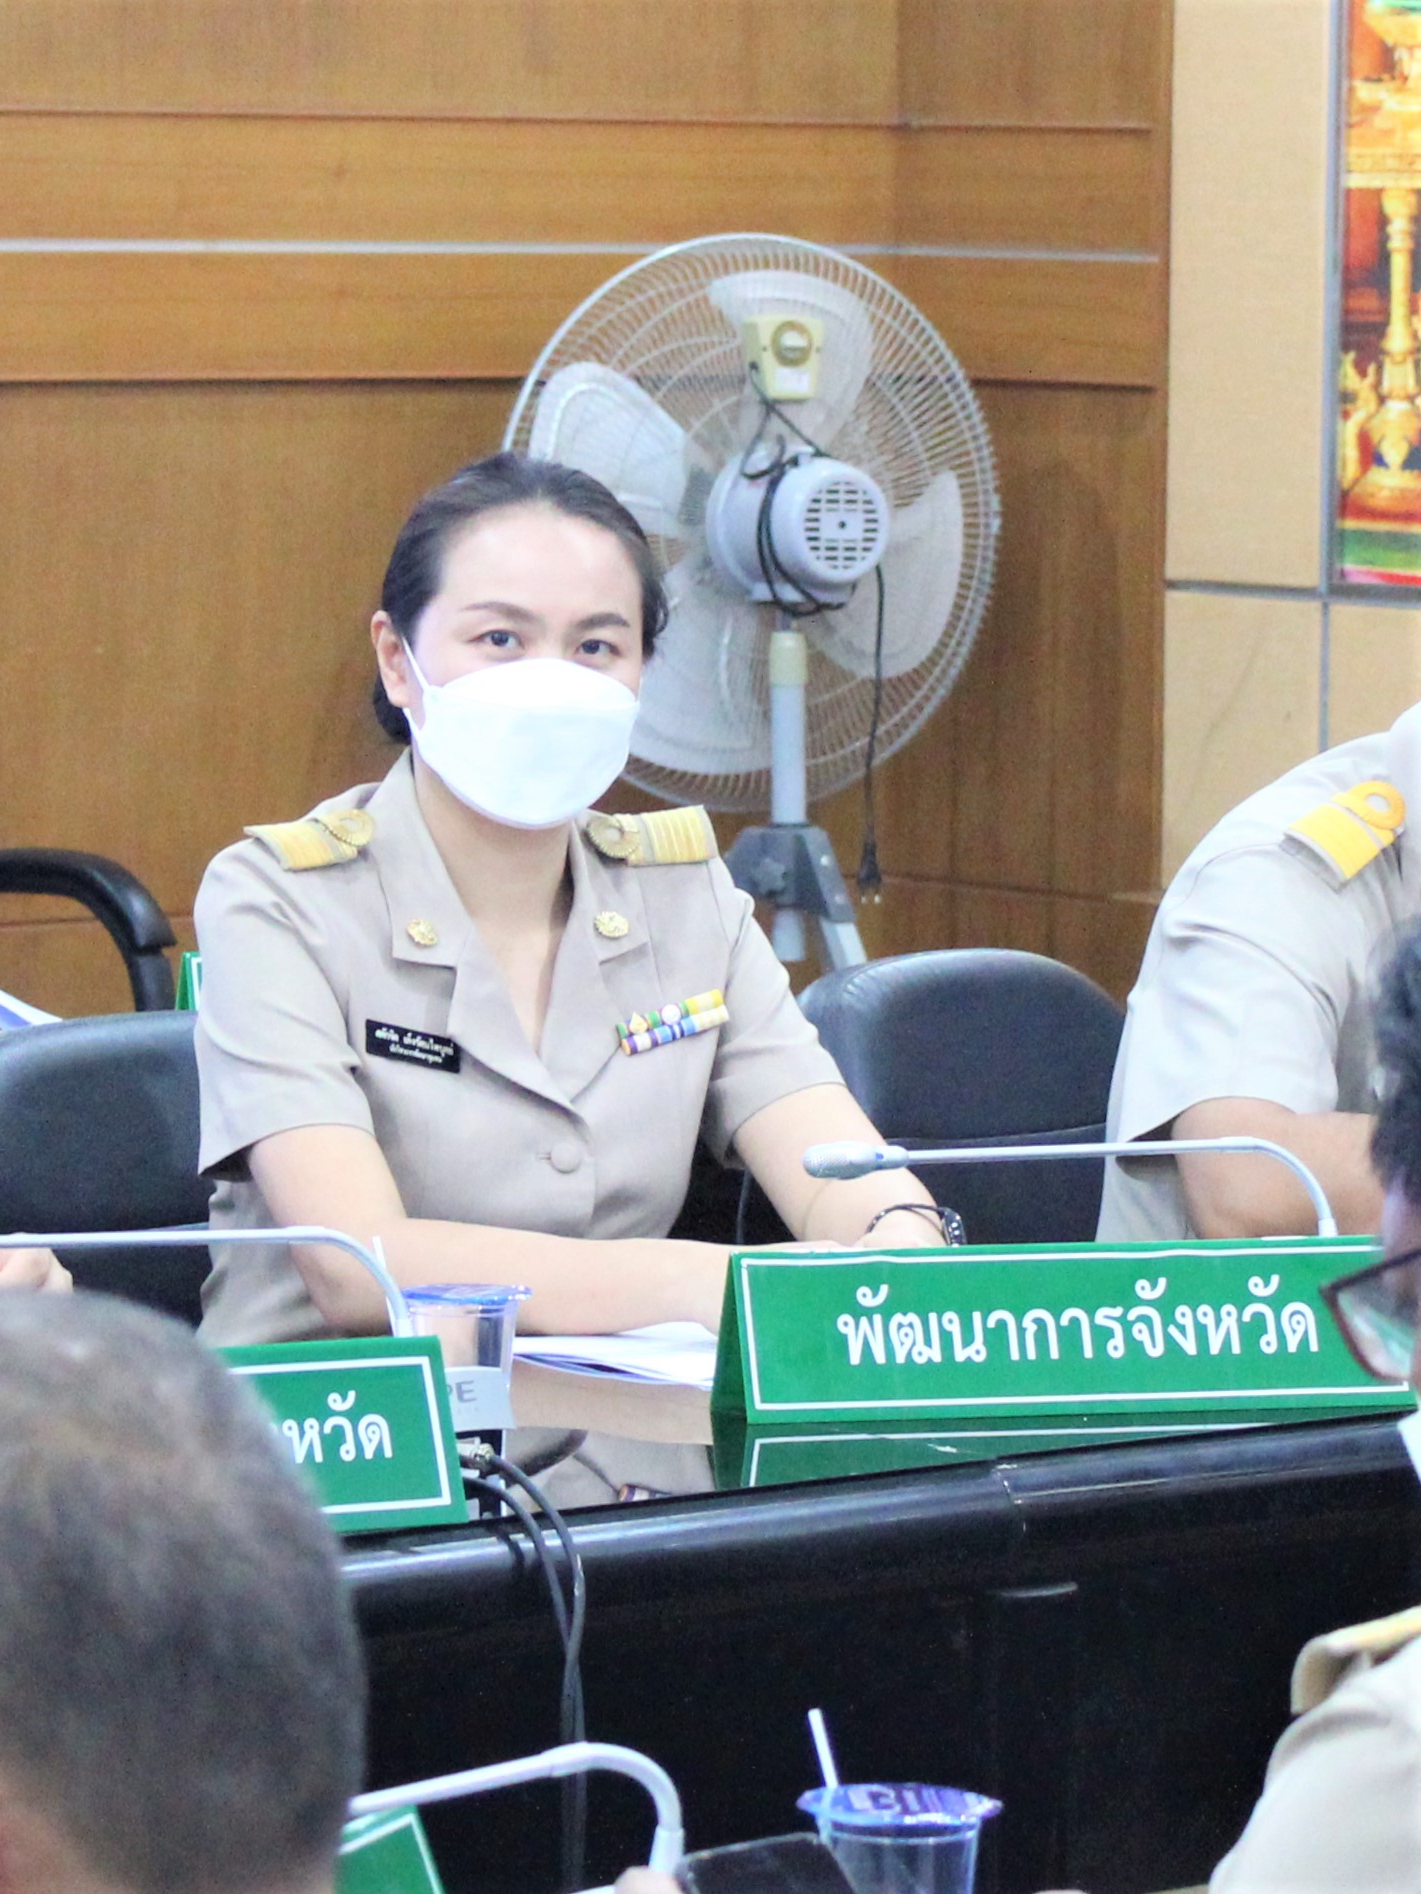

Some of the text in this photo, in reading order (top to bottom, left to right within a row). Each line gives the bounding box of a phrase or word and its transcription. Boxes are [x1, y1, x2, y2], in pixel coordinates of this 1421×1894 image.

[837, 1273, 1320, 1366] พัฒนาการจังหวัด
[273, 1389, 394, 1464] หวัด
